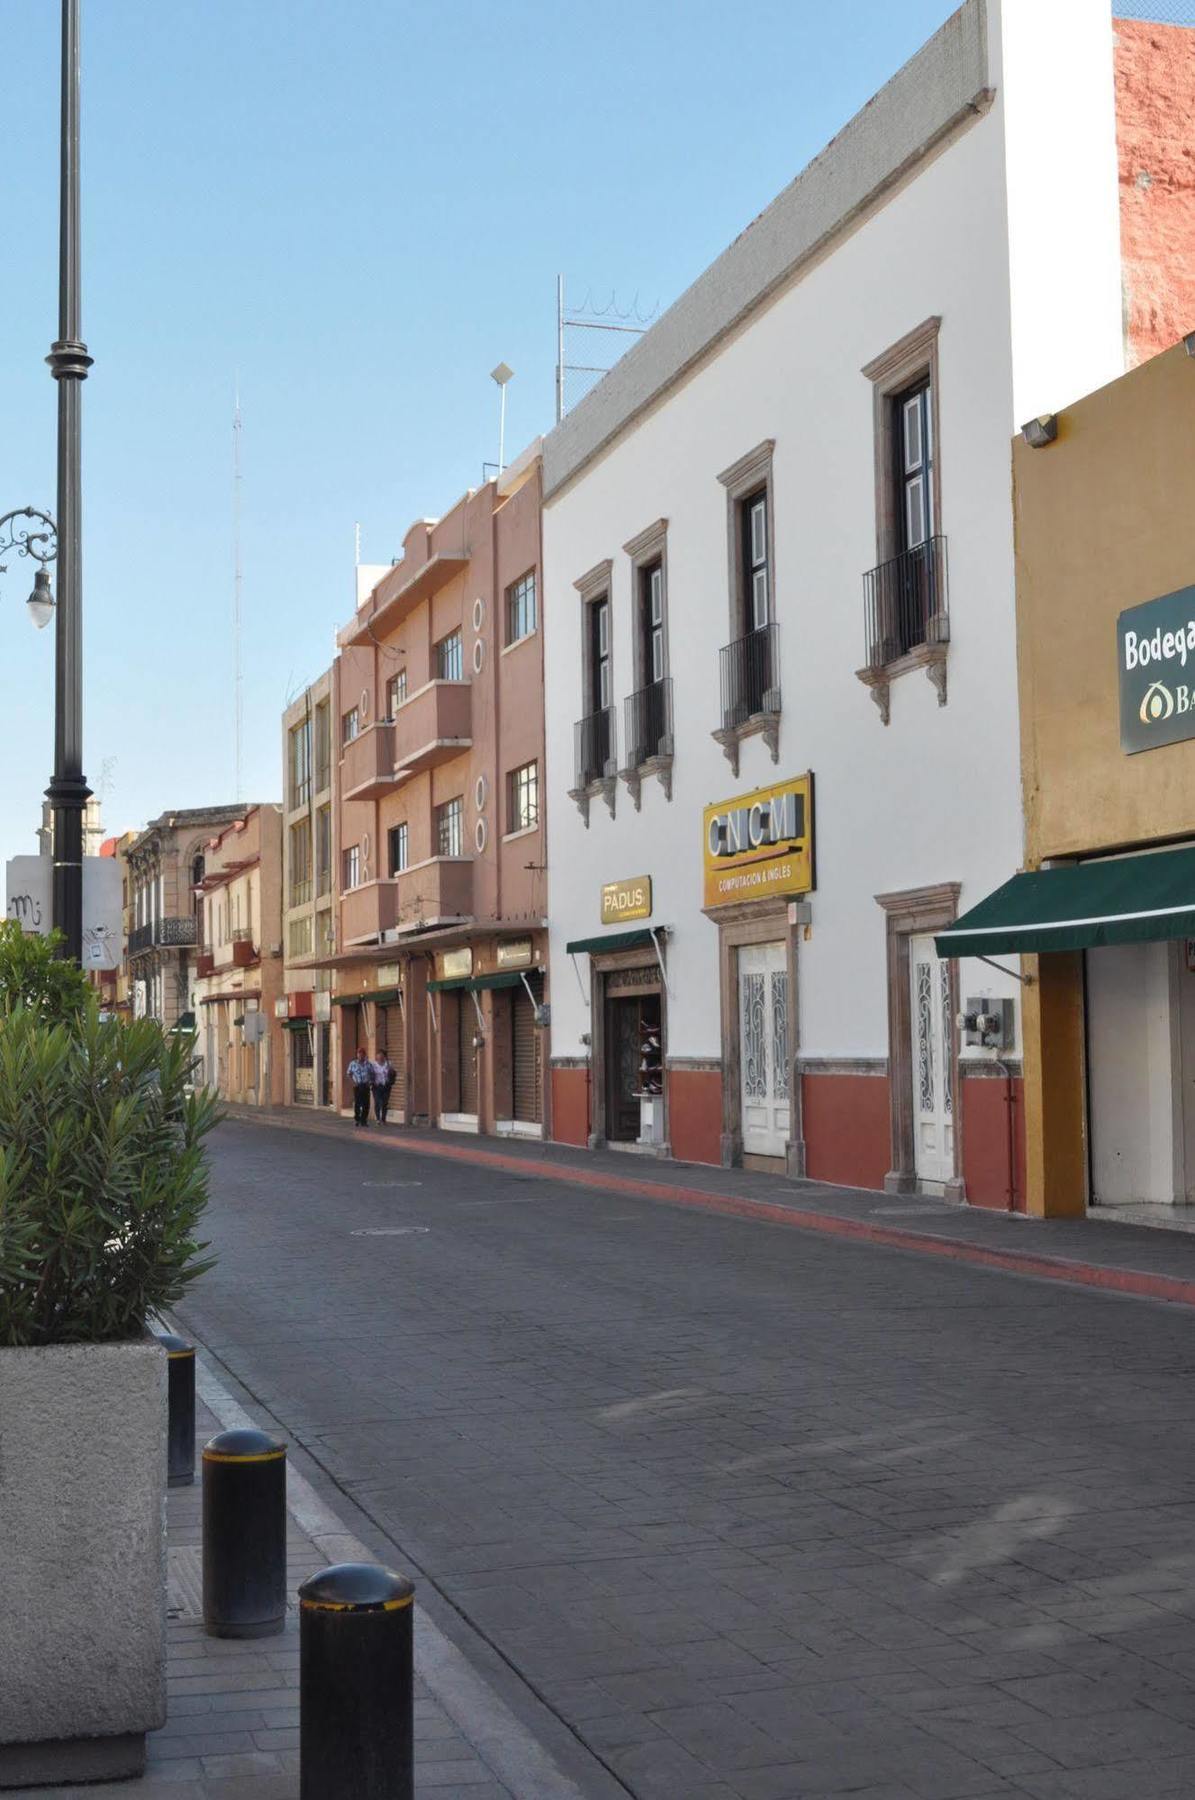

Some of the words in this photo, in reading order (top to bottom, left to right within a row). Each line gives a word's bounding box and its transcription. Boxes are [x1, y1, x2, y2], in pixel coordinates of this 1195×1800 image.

[1124, 620, 1195, 670] Bodega
[708, 793, 800, 857] CNCM
[719, 871, 761, 893] COMPUTACION
[767, 865, 792, 881] INGLES
[604, 888, 643, 912] PADUS
